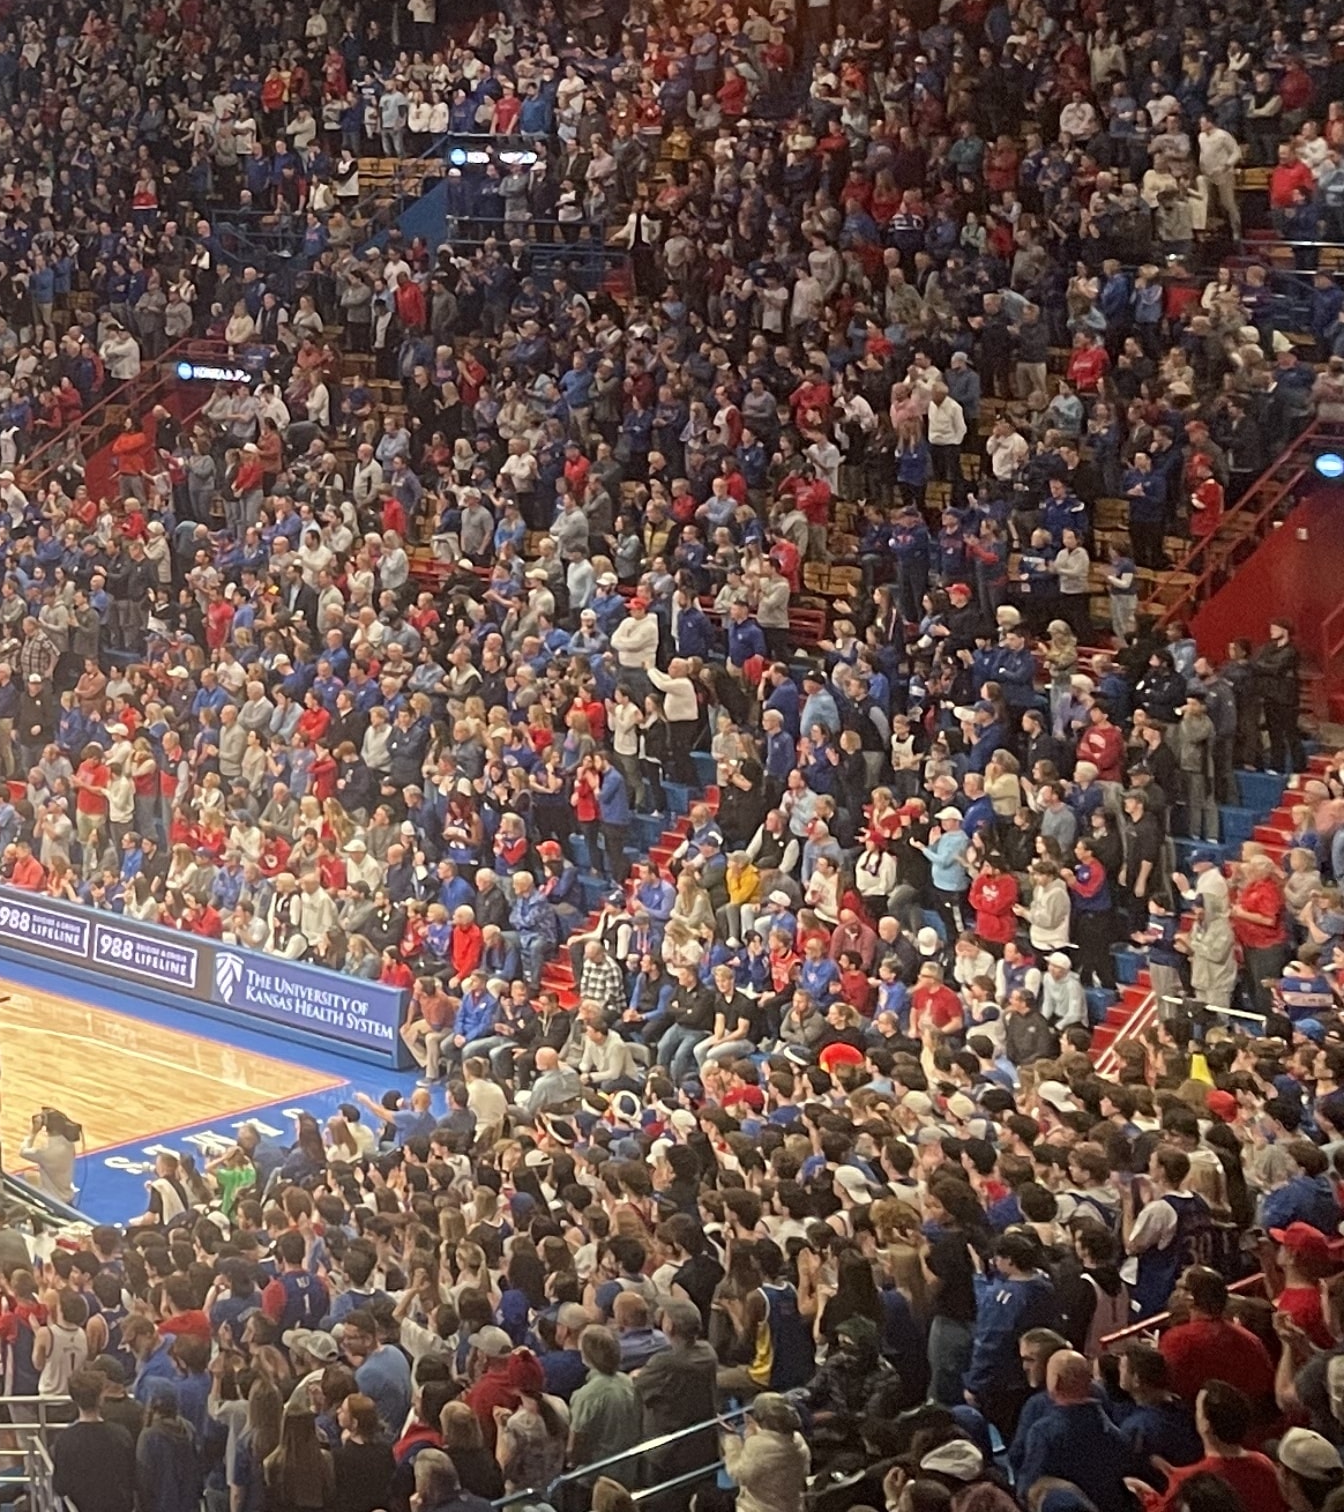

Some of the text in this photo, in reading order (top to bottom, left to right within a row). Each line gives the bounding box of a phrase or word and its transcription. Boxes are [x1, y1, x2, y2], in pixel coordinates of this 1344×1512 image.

[31, 924, 81, 946] LIFELINE
[99, 934, 133, 960] 988
[135, 953, 187, 976] LIFELINE
[245, 969, 369, 1017] THE UNIVERSITY OF
[245, 986, 394, 1040] KANSAS HEALTH SYSTEM
[302, 1293, 311, 1315] 1
